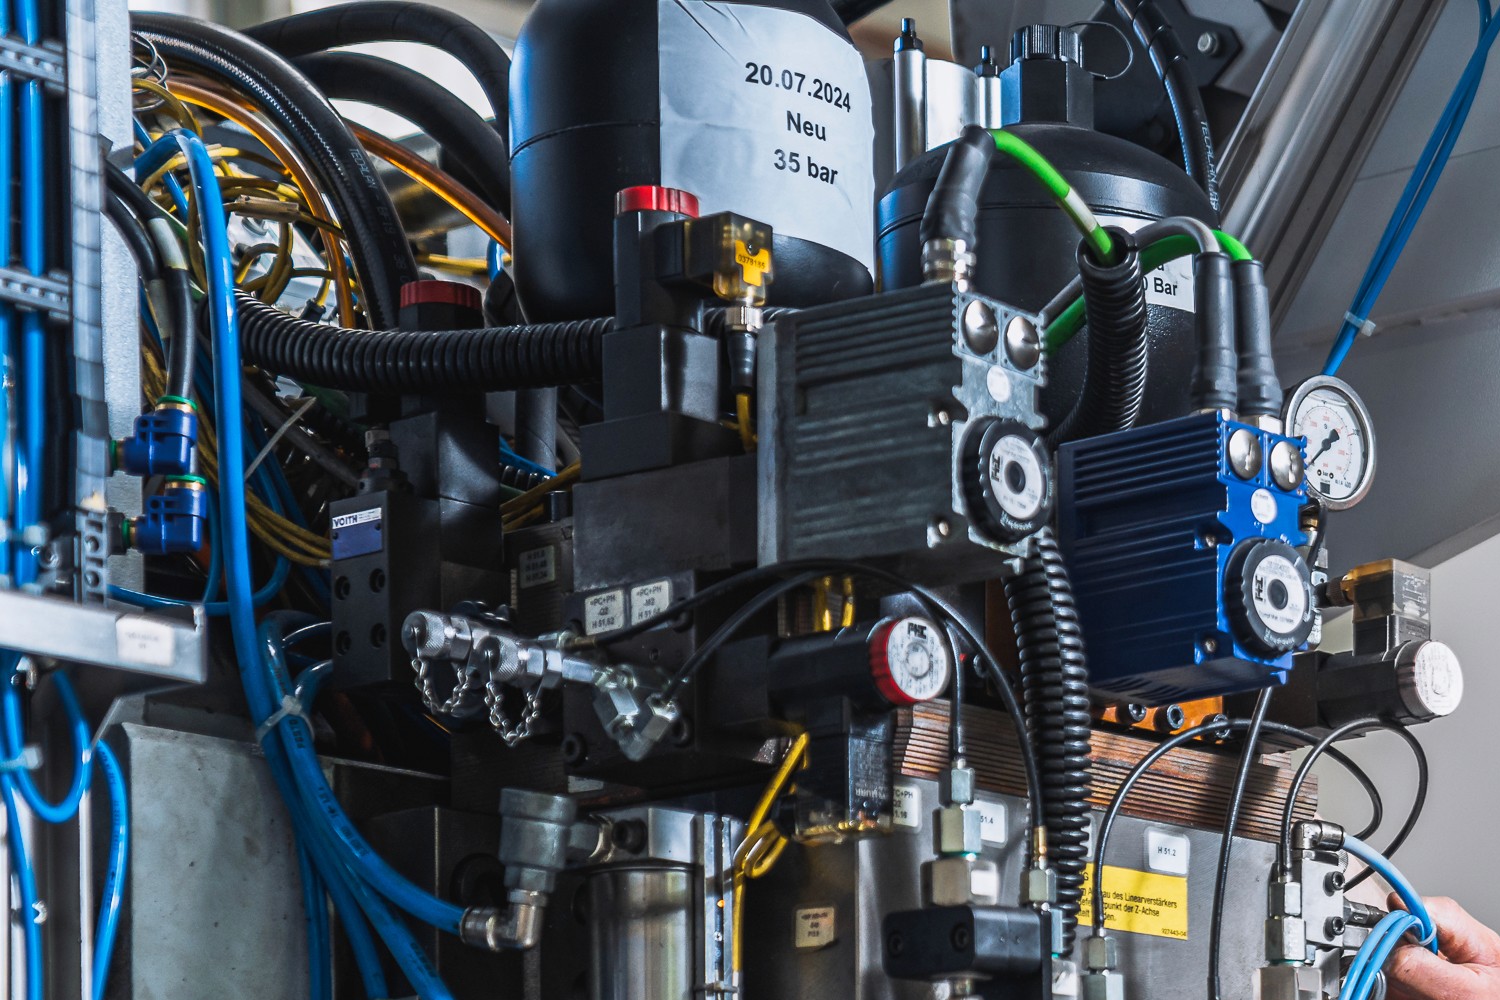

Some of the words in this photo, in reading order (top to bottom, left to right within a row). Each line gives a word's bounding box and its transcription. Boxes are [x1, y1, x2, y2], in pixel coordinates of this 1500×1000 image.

[745, 62, 851, 113] 20.07.2024
[786, 110, 827, 141] Neu
[774, 148, 801, 173] 35
[807, 155, 838, 185] bar
[1154, 277, 1178, 296] Bar
[333, 514, 358, 527] VOITH
[1157, 846, 1163, 854] H
[1164, 847, 1177, 857] 51.2
[1112, 890, 1124, 901] des
[1124, 892, 1178, 909] Linearverstärkers
[1123, 904, 1134, 913] der
[1134, 905, 1160, 917] Z-Achse
